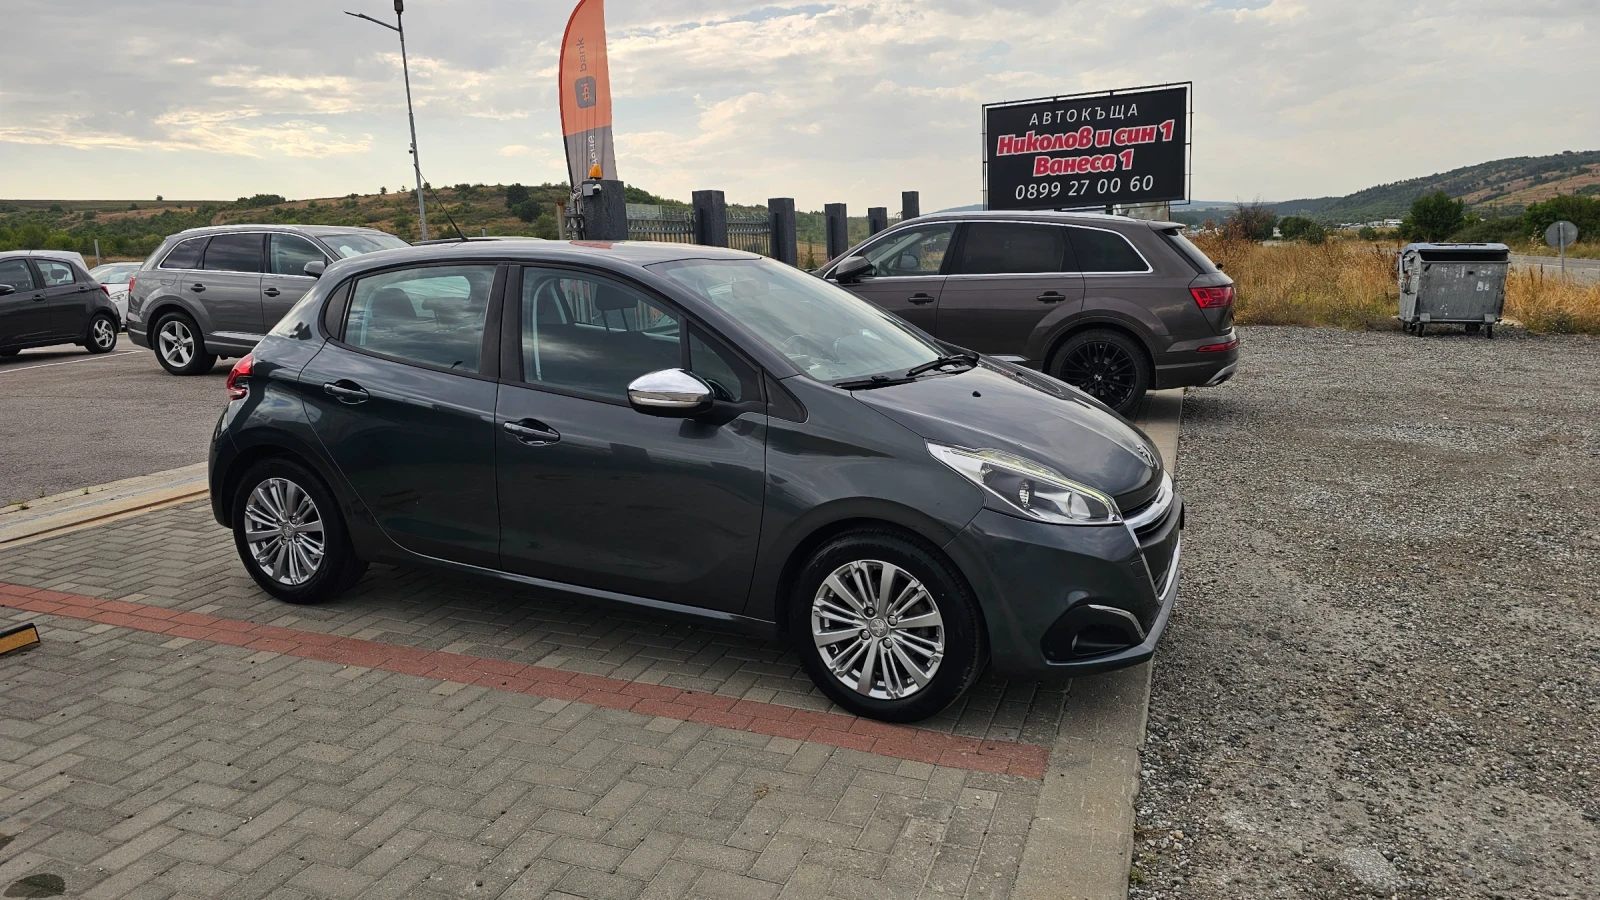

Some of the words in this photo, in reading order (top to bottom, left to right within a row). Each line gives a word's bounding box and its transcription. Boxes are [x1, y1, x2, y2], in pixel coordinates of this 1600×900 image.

[576, 37, 587, 72] bank
[580, 83, 590, 102] tbi
[1029, 103, 1138, 126] АВТОКЪЩА
[996, 125, 1094, 156] Николов
[1095, 129, 1112, 147] и
[1113, 124, 1157, 145] син
[1158, 119, 1175, 142] 1
[1033, 154, 1117, 177] Ванеса
[1119, 149, 1134, 170] 1
[1015, 181, 1061, 200] 0899
[1068, 180, 1090, 196] 27
[1097, 177, 1121, 194] 00
[1130, 175, 1154, 191] 60
